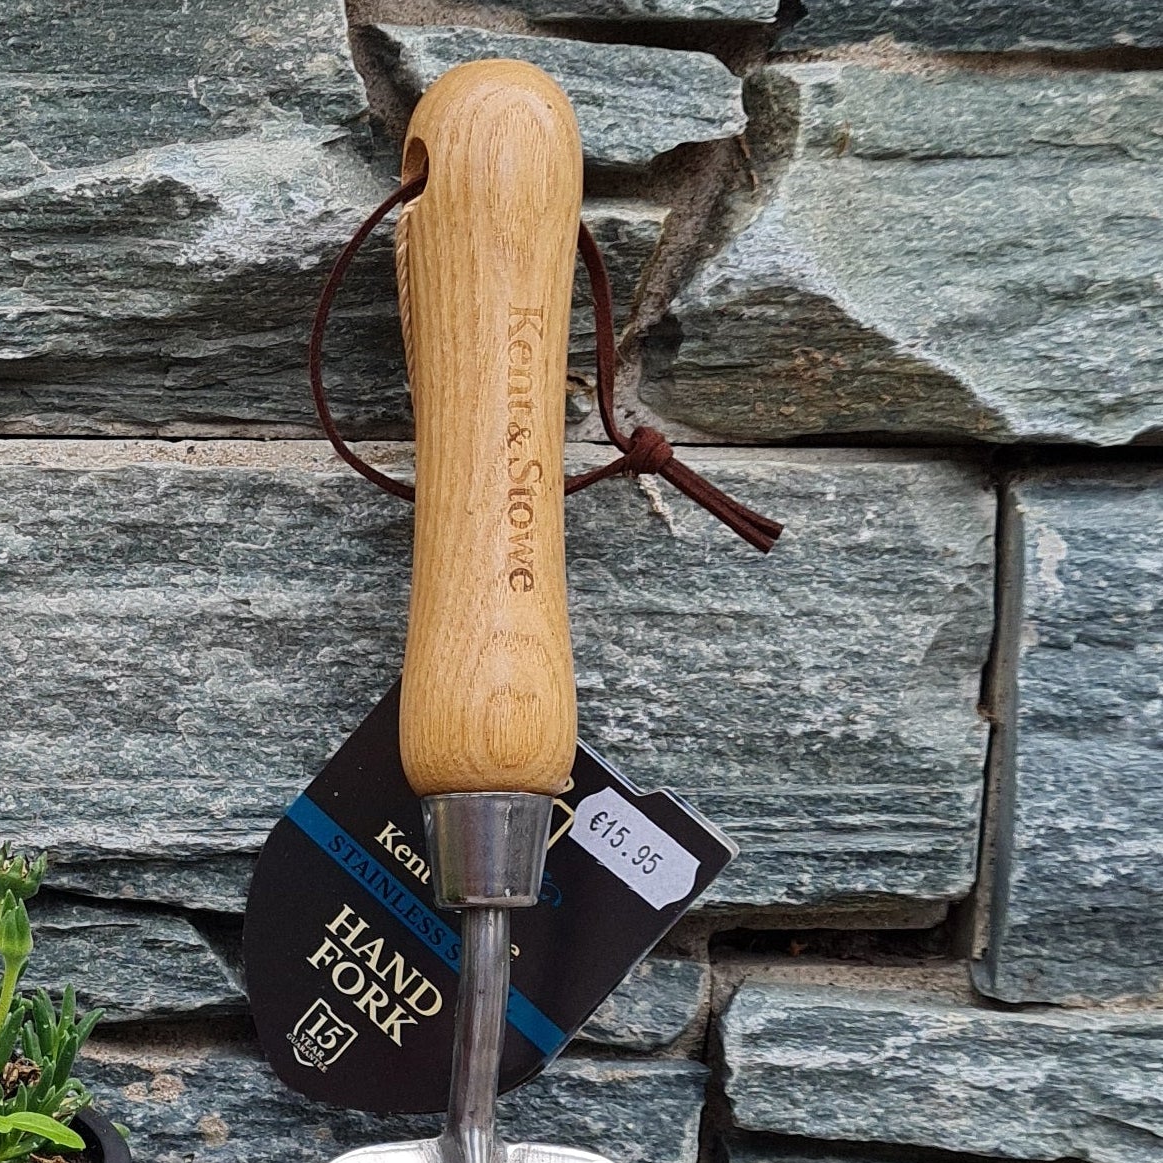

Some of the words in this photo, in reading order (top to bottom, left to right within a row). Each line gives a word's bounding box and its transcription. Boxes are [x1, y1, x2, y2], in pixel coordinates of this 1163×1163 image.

[507, 302, 544, 414] Kent
[507, 457, 543, 592] Stowe
[328, 834, 446, 946] STAINLESS
[589, 811, 664, 875] €15.95
[306, 936, 419, 1047] FORK
[325, 903, 443, 1016] HAND
[286, 1032, 328, 1073] GUARANTEE
[300, 1033, 325, 1060] YEAR
[305, 1012, 344, 1049] 15
